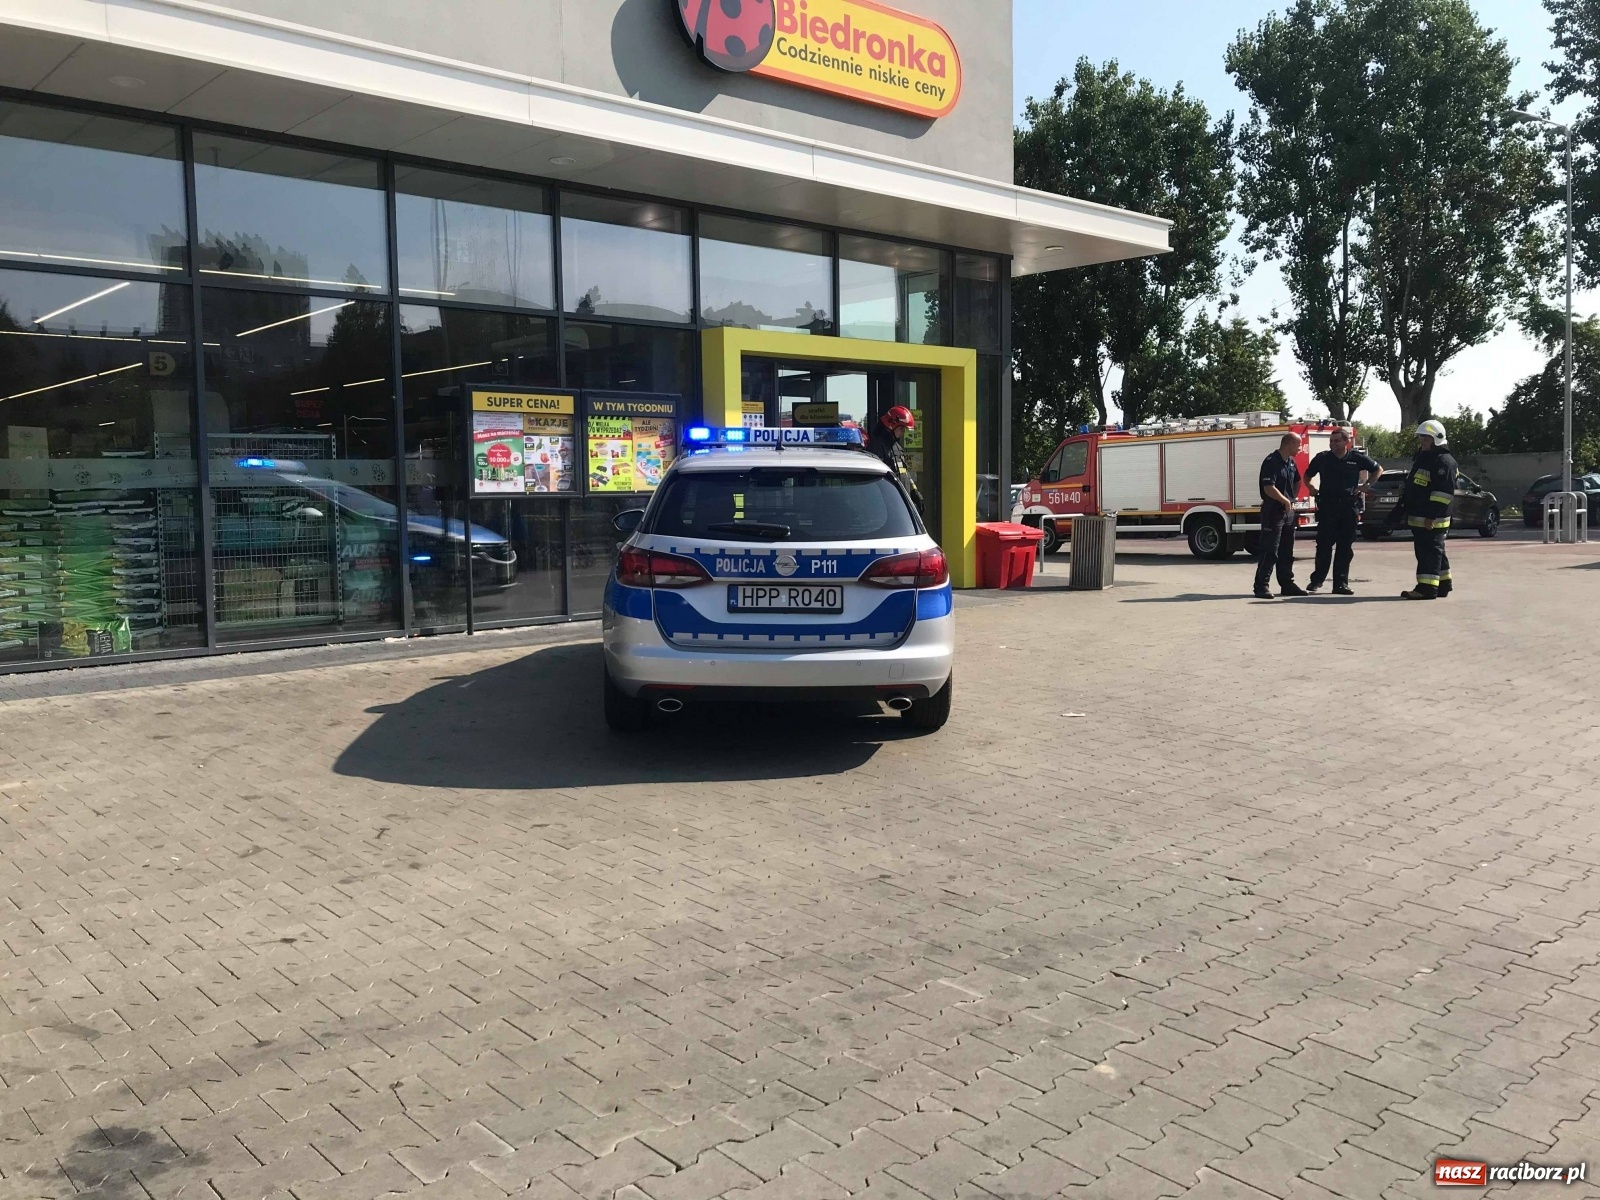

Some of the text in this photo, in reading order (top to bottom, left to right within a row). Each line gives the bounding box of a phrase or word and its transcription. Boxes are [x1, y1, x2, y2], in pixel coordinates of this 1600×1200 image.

[776, 0, 946, 78] Biedronka
[776, 37, 946, 102] Codziennie niskie ceny
[154, 356, 168, 371] 5
[486, 396, 560, 410] SUPER CENA!
[593, 401, 674, 413] W TYM TYGODNIU
[716, 558, 766, 574] POLICJA
[811, 559, 837, 574] P111
[742, 588, 837, 607] HPP R040
